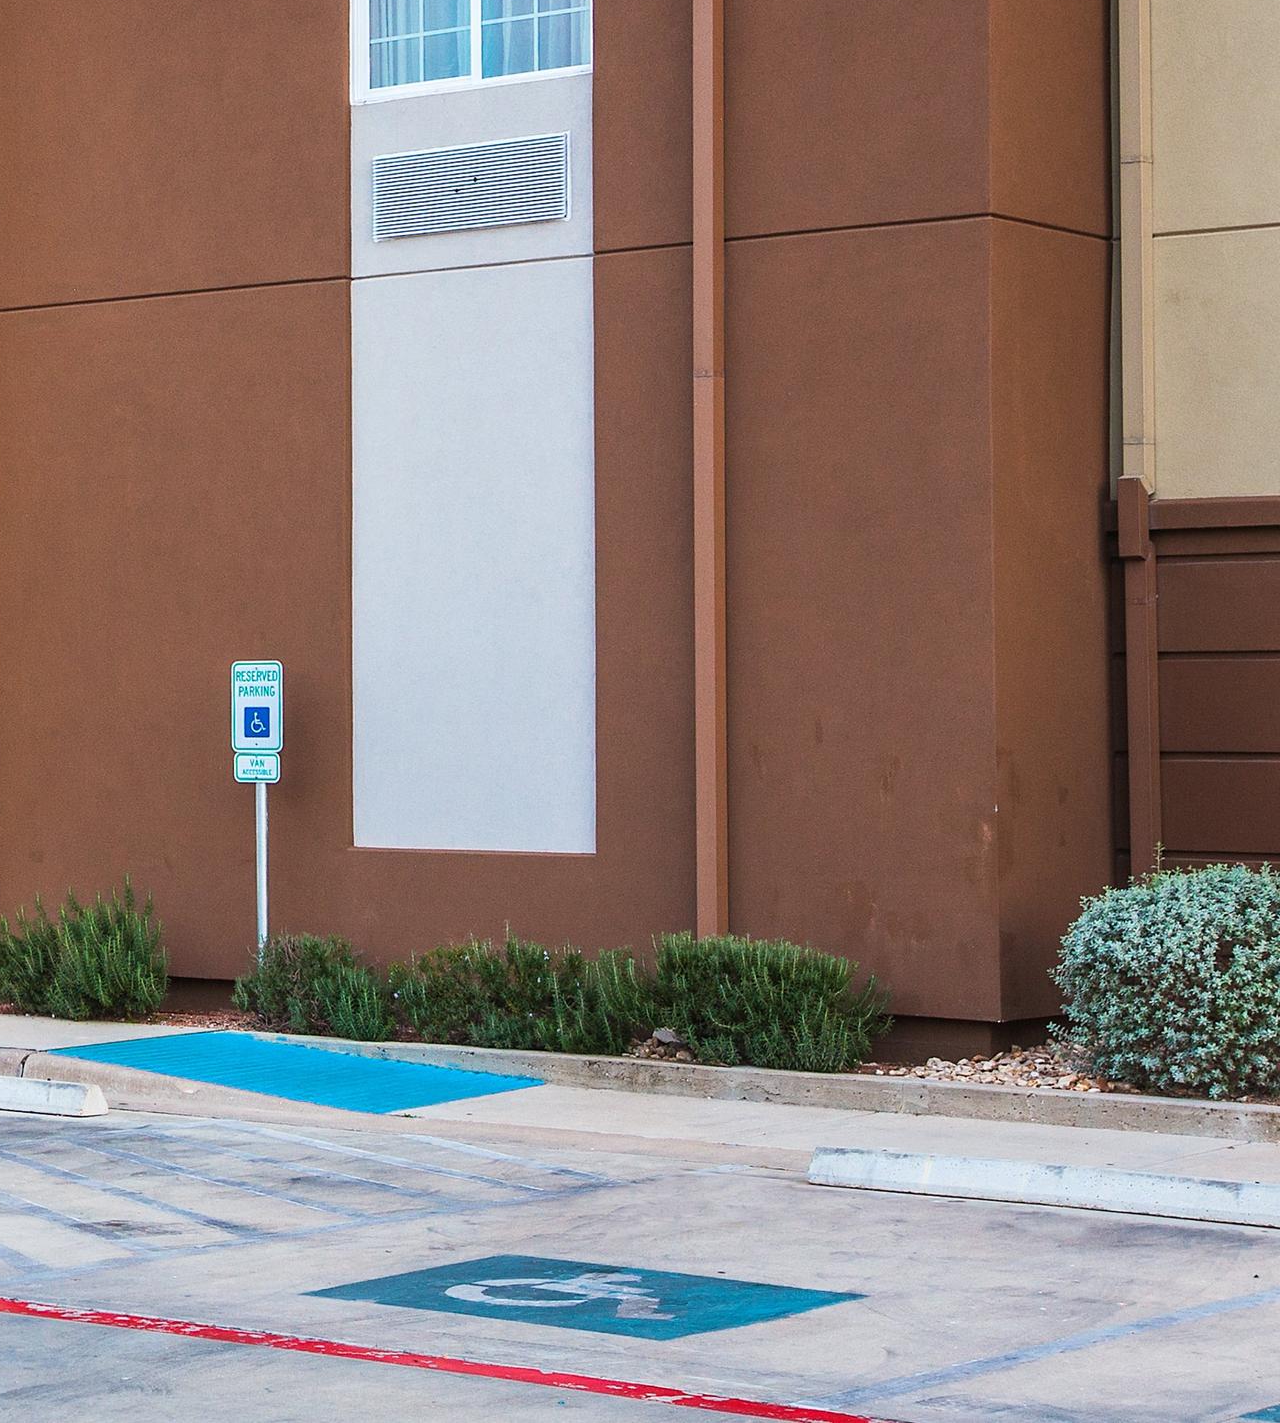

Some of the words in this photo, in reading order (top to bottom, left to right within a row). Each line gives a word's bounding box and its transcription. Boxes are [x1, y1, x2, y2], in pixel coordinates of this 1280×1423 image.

[235, 670, 278, 682] RESERVED
[238, 686, 276, 697] PARKING
[249, 759, 265, 767] VAN
